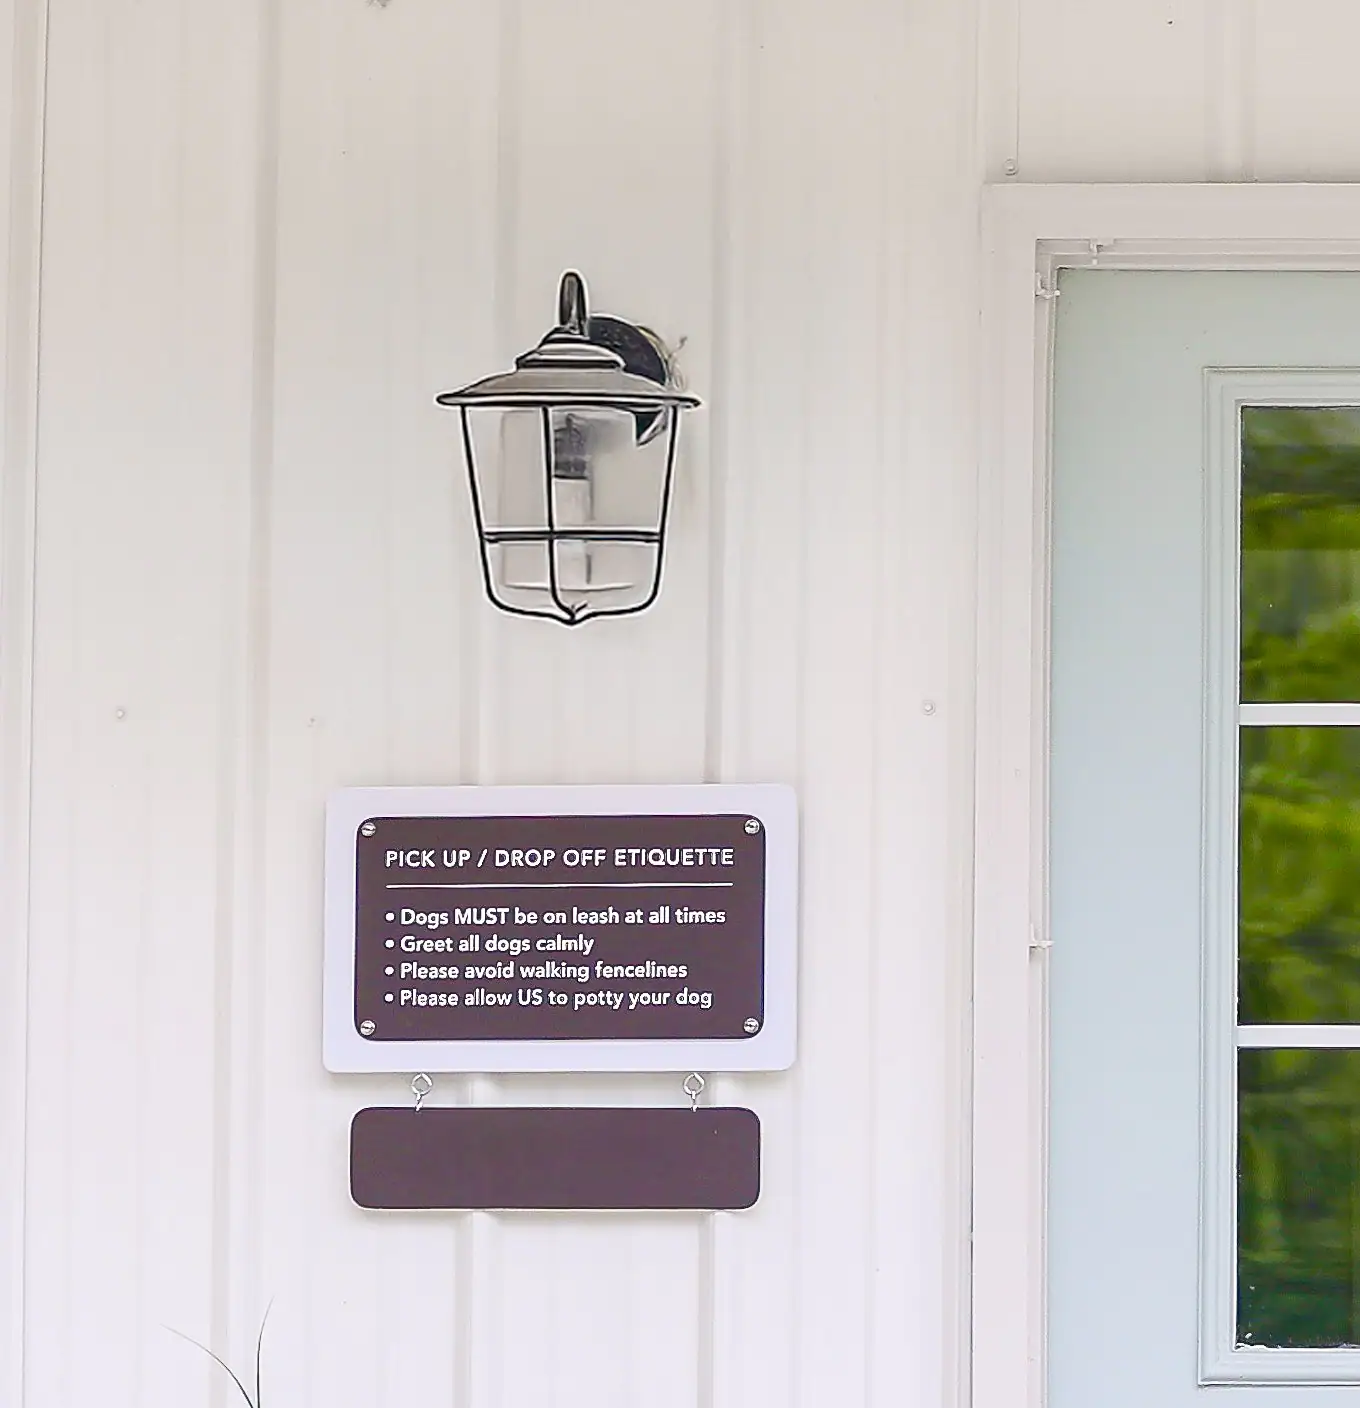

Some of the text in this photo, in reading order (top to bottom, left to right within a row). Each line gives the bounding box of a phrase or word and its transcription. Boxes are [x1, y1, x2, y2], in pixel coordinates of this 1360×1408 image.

[385, 848, 734, 868] PICK UP / DROP OFF ETIQUETTE
[400, 905, 726, 929] Dogs MUST be on leash at all times
[400, 933, 595, 956] Greet all dogs calmly
[400, 960, 688, 983] Please avoid walking fencelines
[400, 986, 713, 1011] Please allow US to potty your dog
